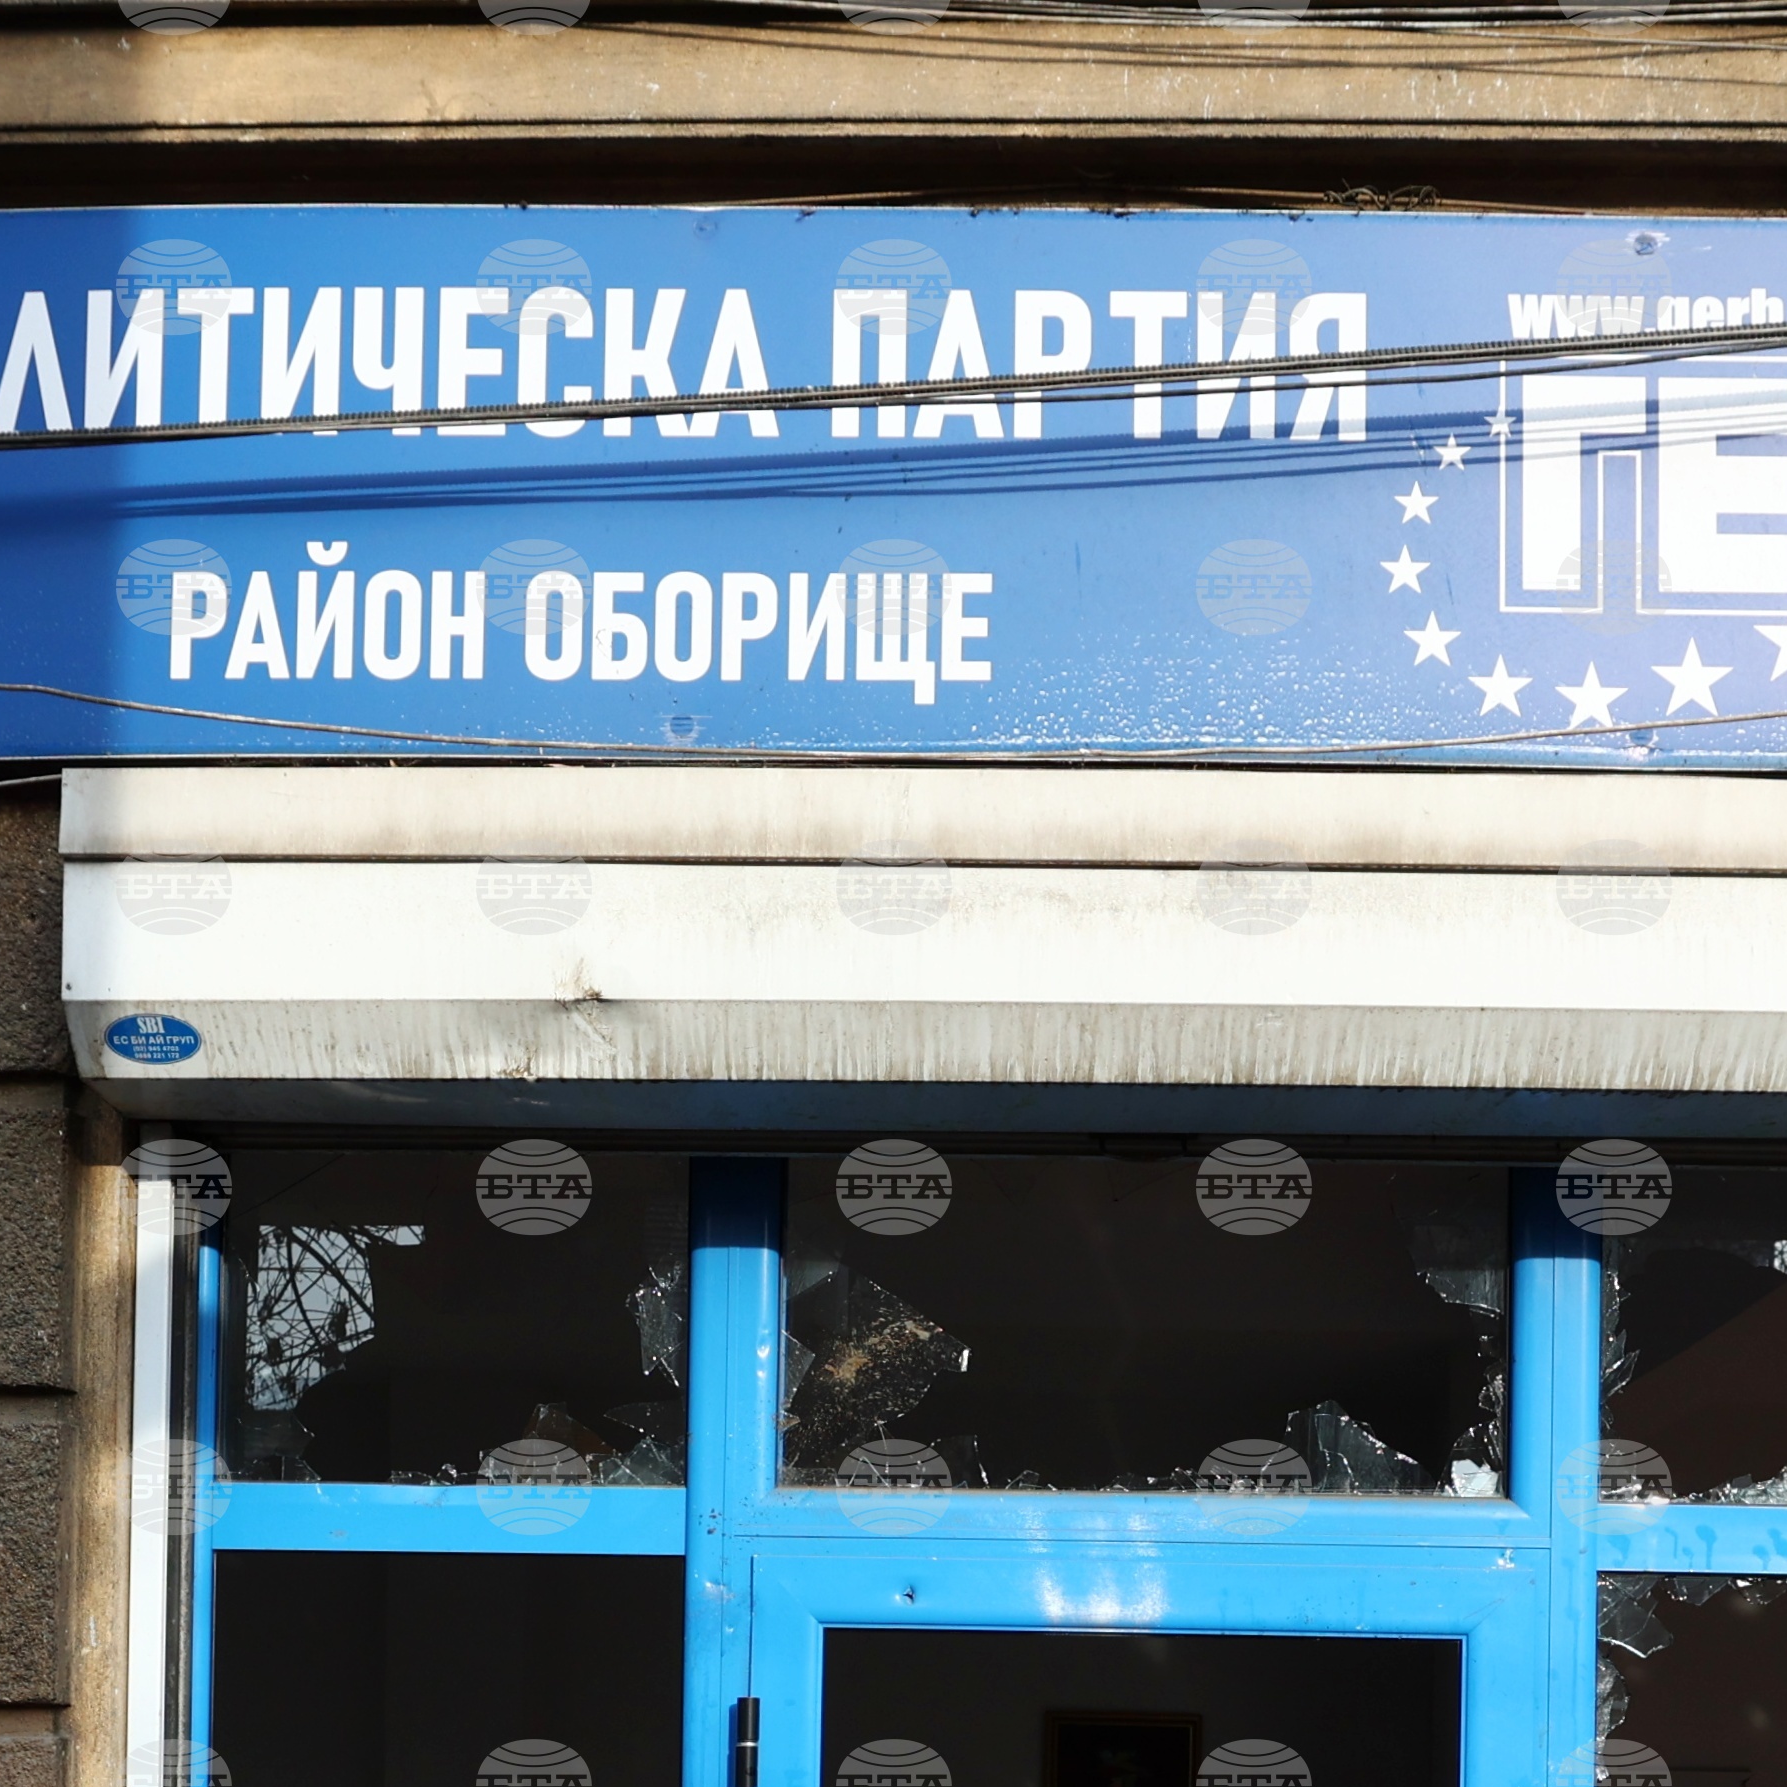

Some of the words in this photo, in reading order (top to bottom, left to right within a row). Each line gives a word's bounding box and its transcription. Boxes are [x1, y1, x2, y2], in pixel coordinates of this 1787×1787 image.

[831, 289, 1367, 441] ПАРТИЯ
[170, 540, 484, 680] РАЙОН
[524, 569, 993, 706] ОБОРИЩЕ
[113, 1036, 129, 1044] ЕС
[131, 1036, 146, 1044] БИ
[148, 1034, 164, 1044] АЙ
[166, 1036, 195, 1044] ГРУП
[136, 1016, 165, 1034] SBI
